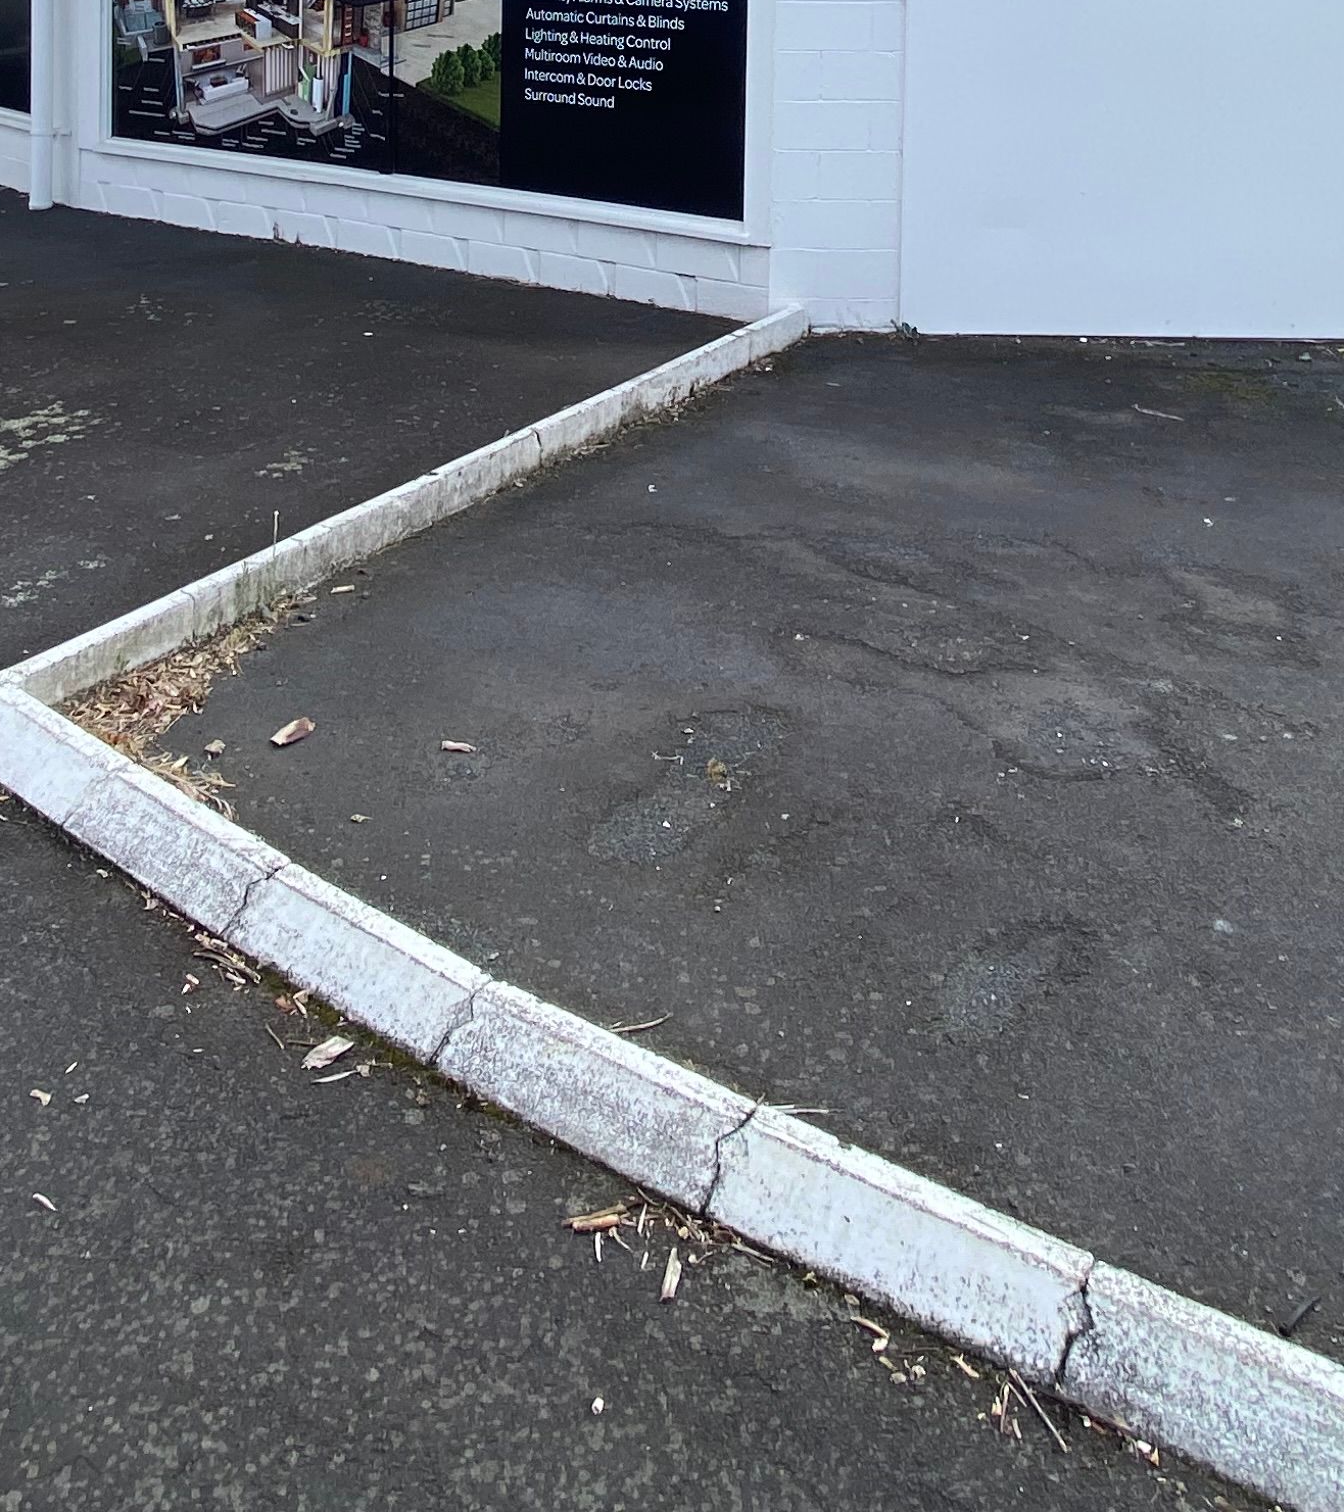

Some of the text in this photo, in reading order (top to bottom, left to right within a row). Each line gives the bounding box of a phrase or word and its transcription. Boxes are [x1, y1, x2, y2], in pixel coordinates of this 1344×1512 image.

[525, 8, 685, 30] Automatic Curtains & Blinds
[525, 28, 671, 51] Lighting & Heating Control
[524, 48, 664, 71] Multiroom Video & Audio
[524, 68, 653, 91] Intercom & Door Locks
[524, 88, 615, 108] Surround Sound
